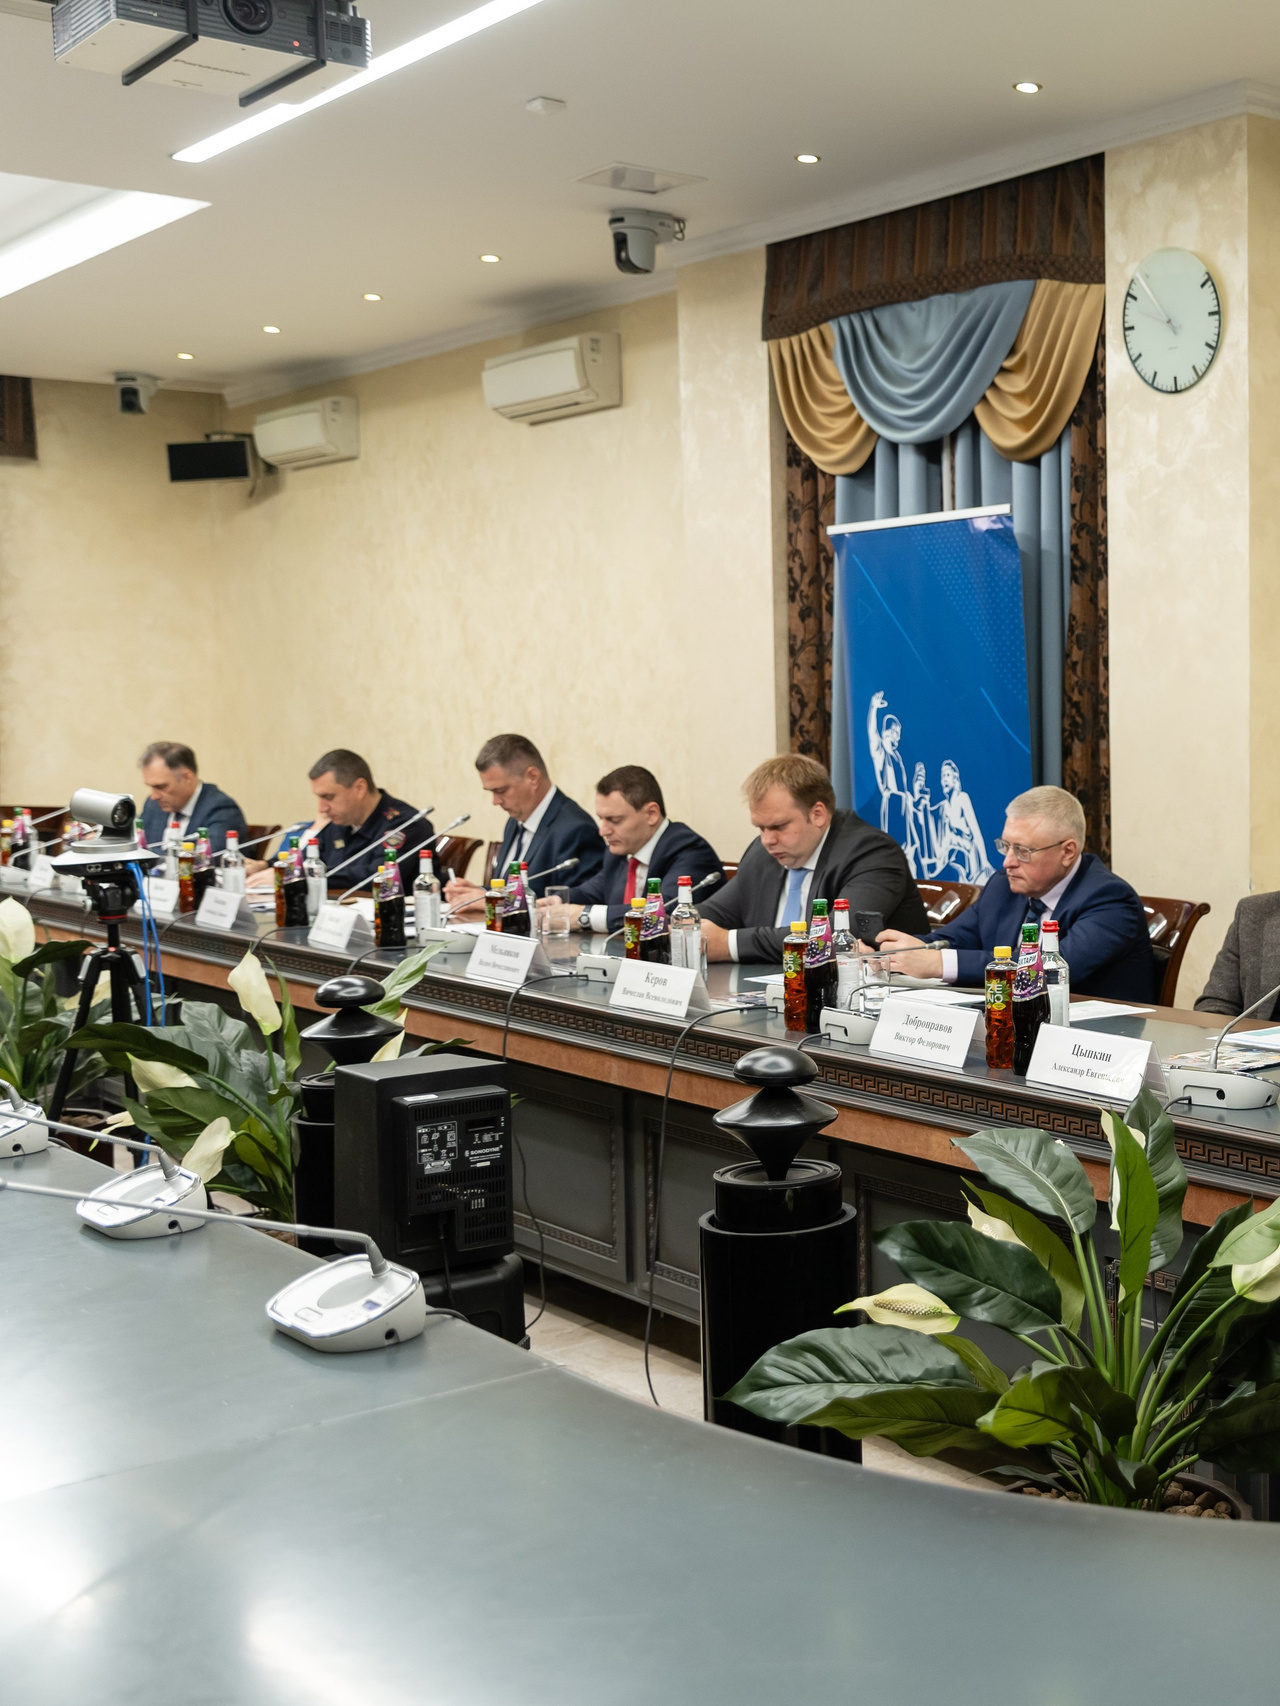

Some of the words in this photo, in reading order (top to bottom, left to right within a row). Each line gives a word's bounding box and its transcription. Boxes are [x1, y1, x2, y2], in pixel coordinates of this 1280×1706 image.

[645, 972, 668, 987] Керов
[902, 1013, 953, 1034] Добронравов
[893, 1031, 916, 1045] Виктор
[916, 1036, 951, 1052] Федорович
[1071, 1043, 1112, 1062] Цыпкин
[1051, 1062, 1085, 1077] Александр
